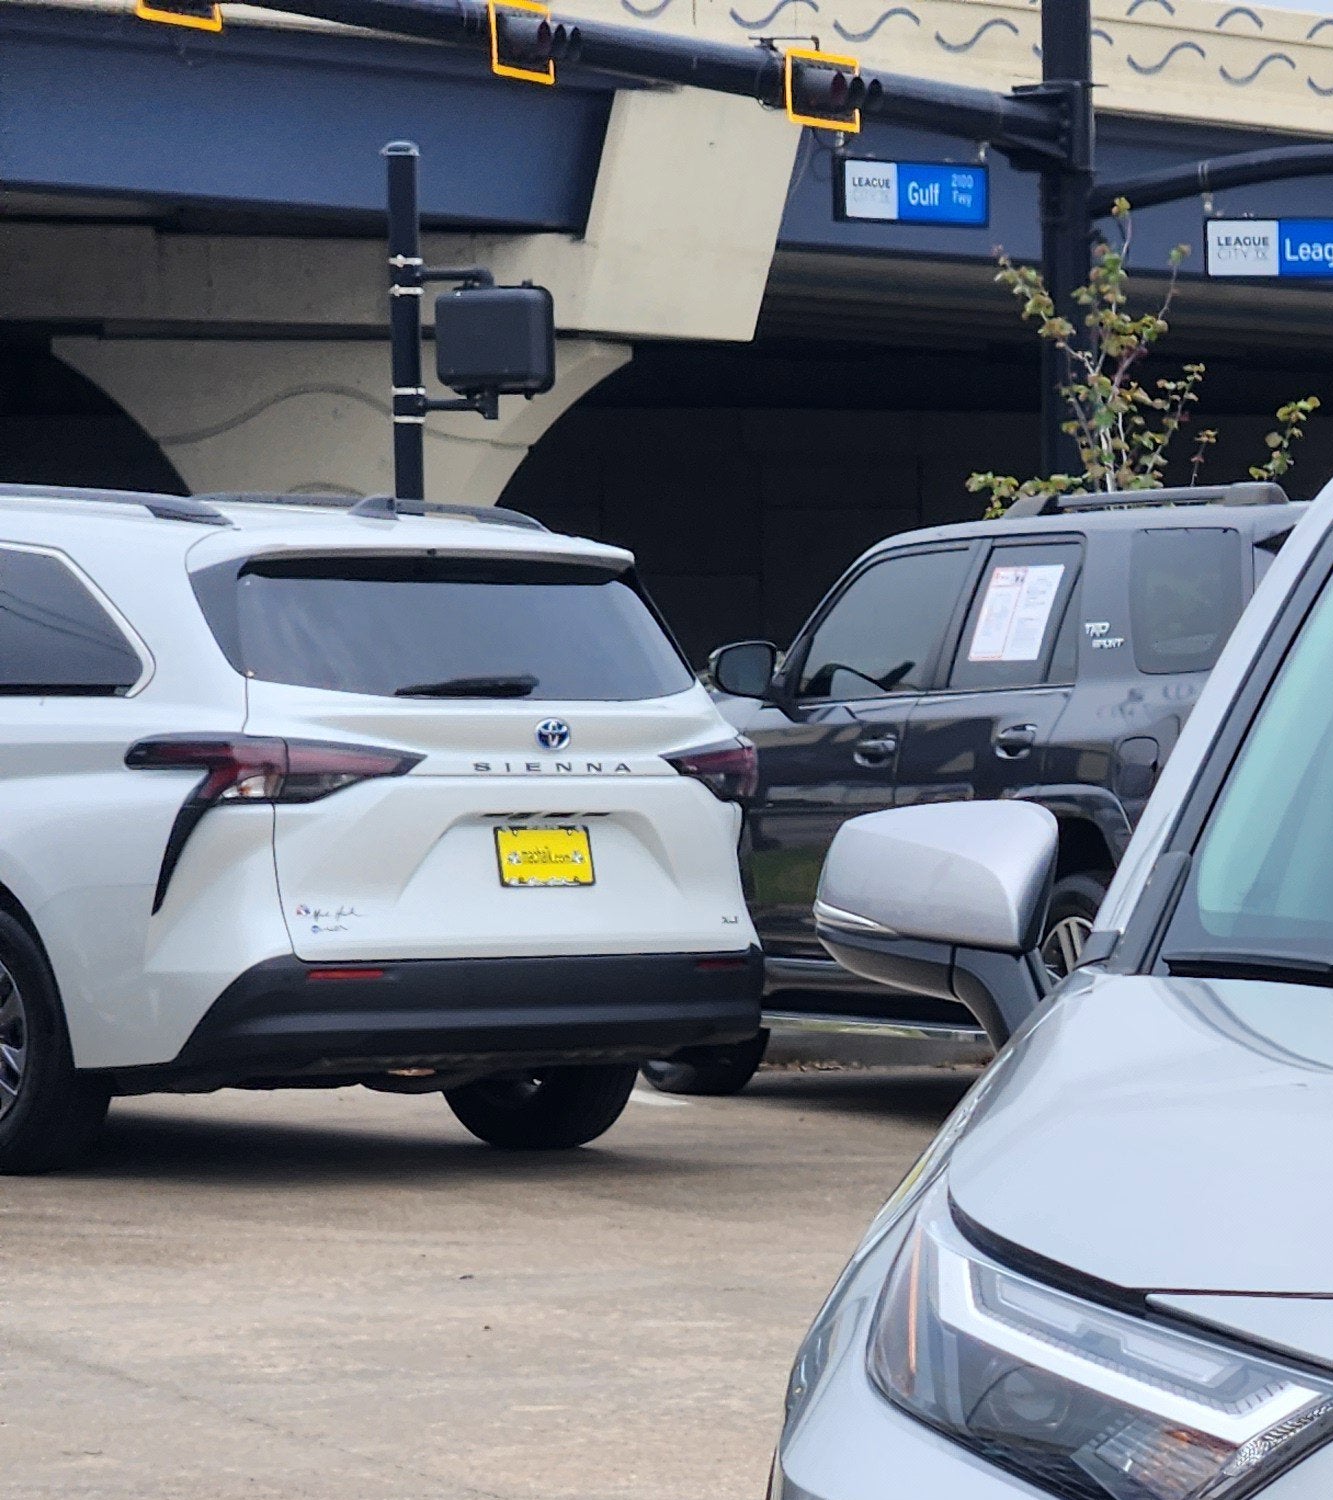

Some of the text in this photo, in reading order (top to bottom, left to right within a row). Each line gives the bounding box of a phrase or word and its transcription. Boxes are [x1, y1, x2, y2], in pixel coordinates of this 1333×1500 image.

[852, 177, 890, 189] LEAGUE
[907, 181, 940, 206] Gulf
[1217, 236, 1269, 246] LEAGUE
[473, 762, 631, 772] SIENNA
